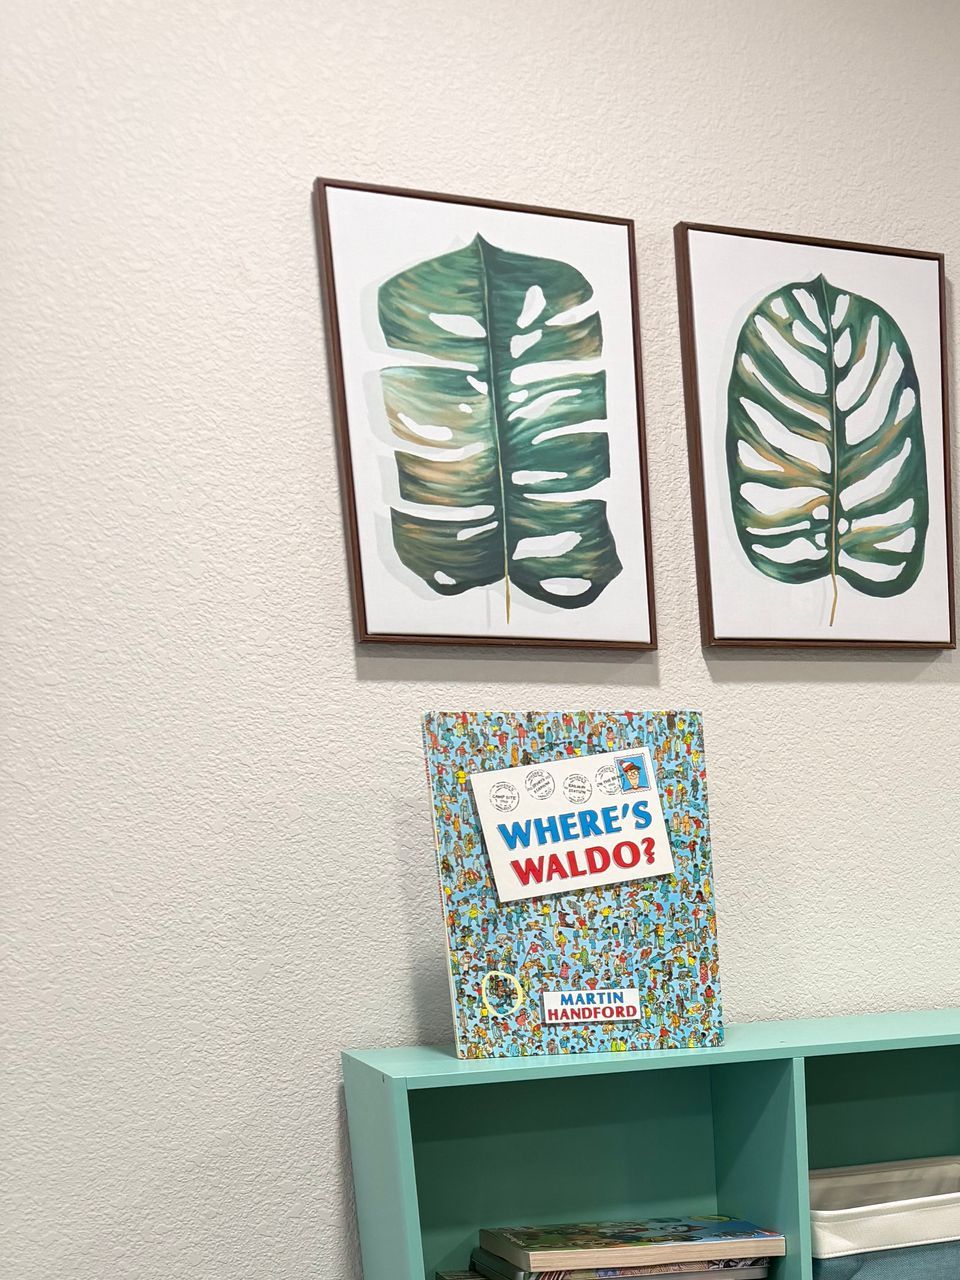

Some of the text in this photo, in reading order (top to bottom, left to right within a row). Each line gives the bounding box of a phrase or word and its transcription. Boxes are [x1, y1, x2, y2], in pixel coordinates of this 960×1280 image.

[496, 800, 653, 850] WHERE'S
[510, 837, 656, 887] WALDO?
[548, 1005, 637, 1021] HANDFORD
[560, 992, 624, 1006] MARTIN
